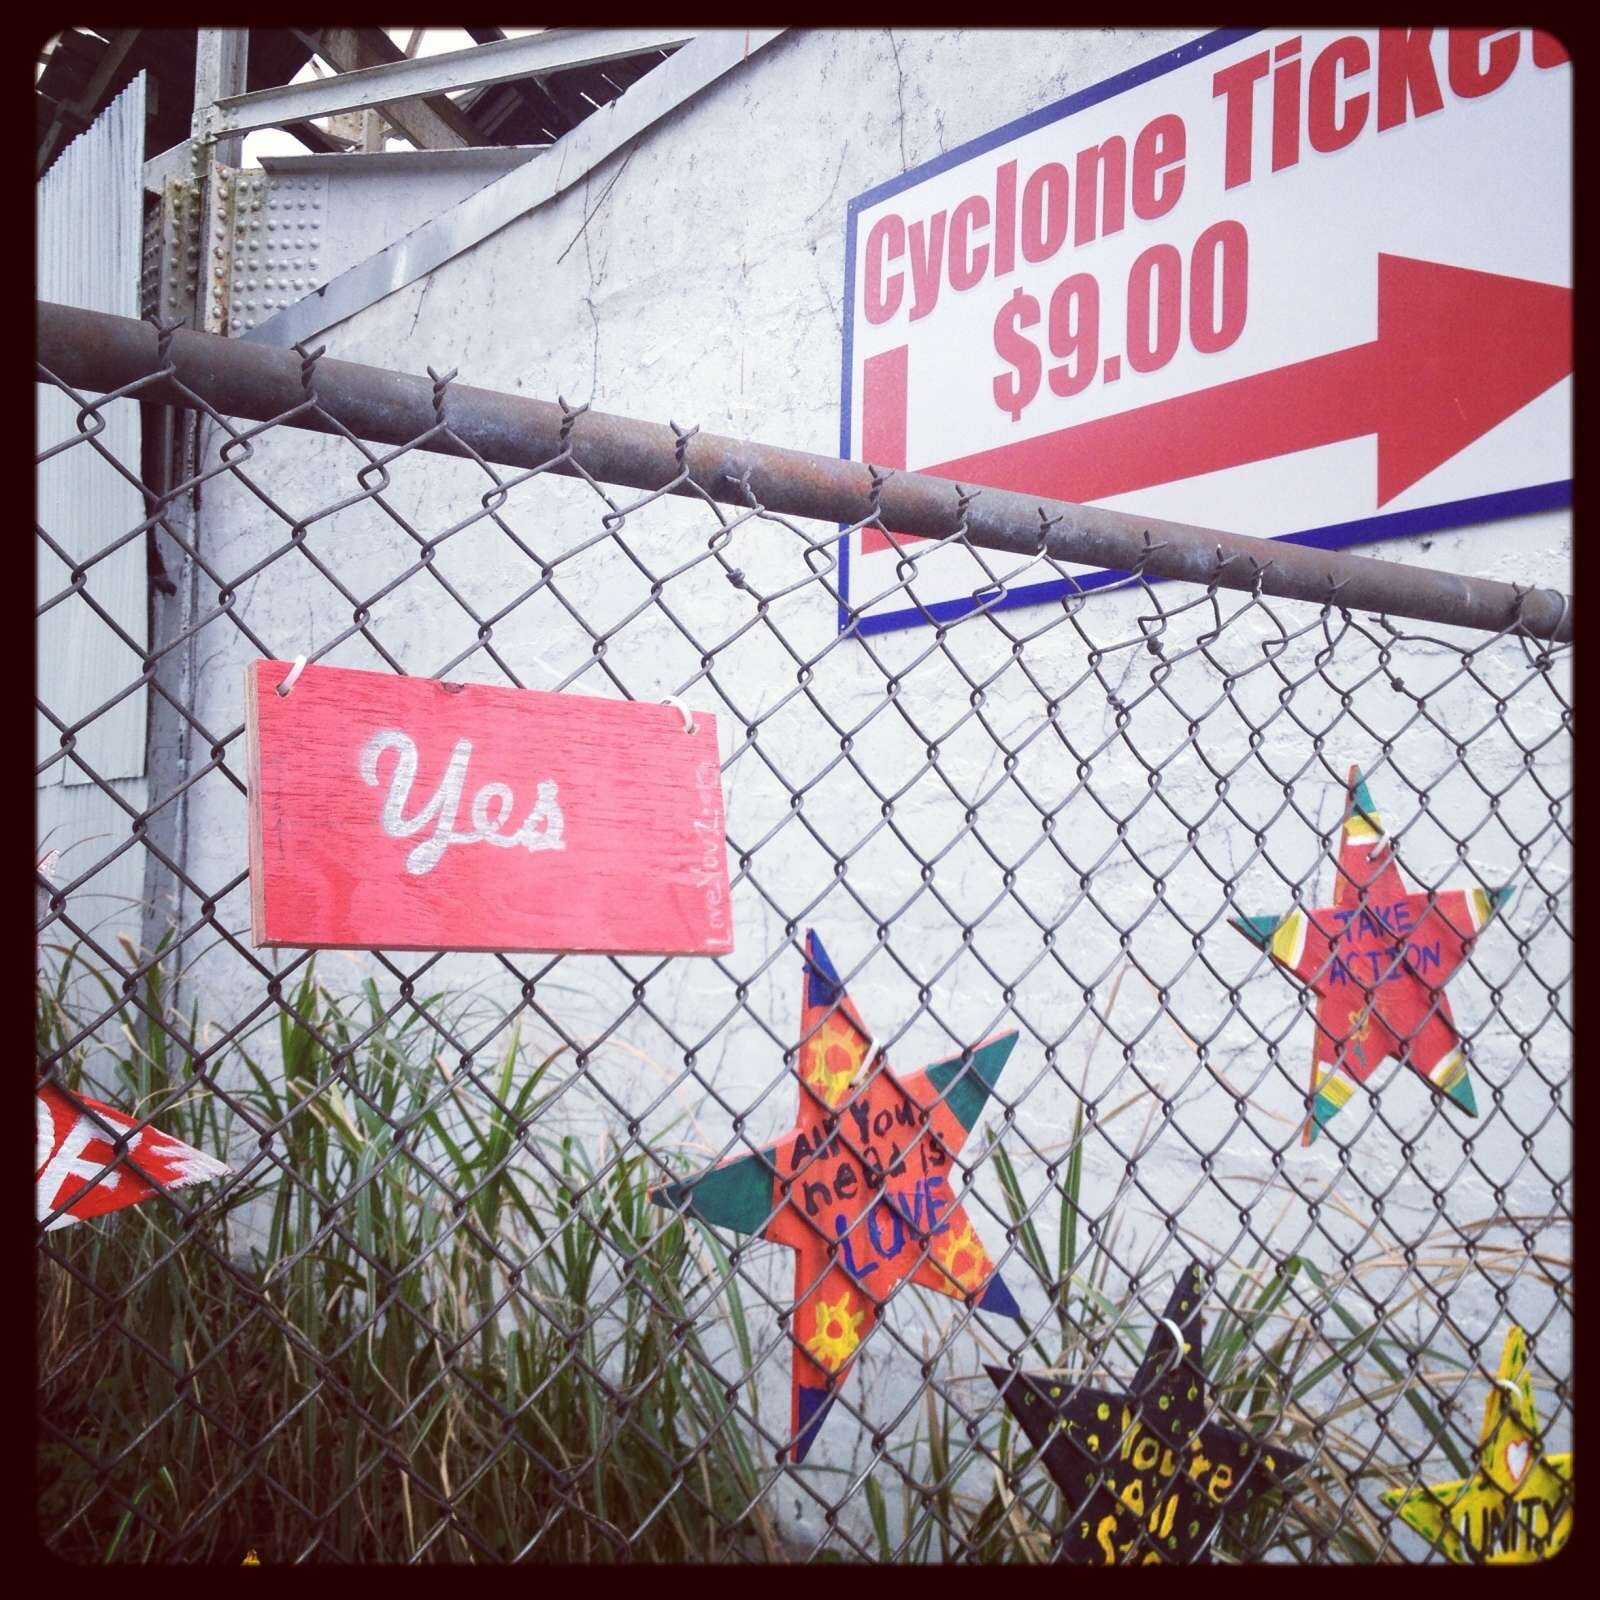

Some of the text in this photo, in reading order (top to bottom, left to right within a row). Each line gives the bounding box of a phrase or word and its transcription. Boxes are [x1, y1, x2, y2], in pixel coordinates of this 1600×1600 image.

[863, 27, 1574, 327] Cyclone Ticke
[992, 219, 1249, 422] $9.00
[359, 727, 566, 875] Yes
[1328, 942, 1442, 986] ACTION
[1333, 900, 1415, 942] TAKE
[835, 1176, 951, 1280] LOVE
[1461, 1496, 1566, 1562] UNITY
